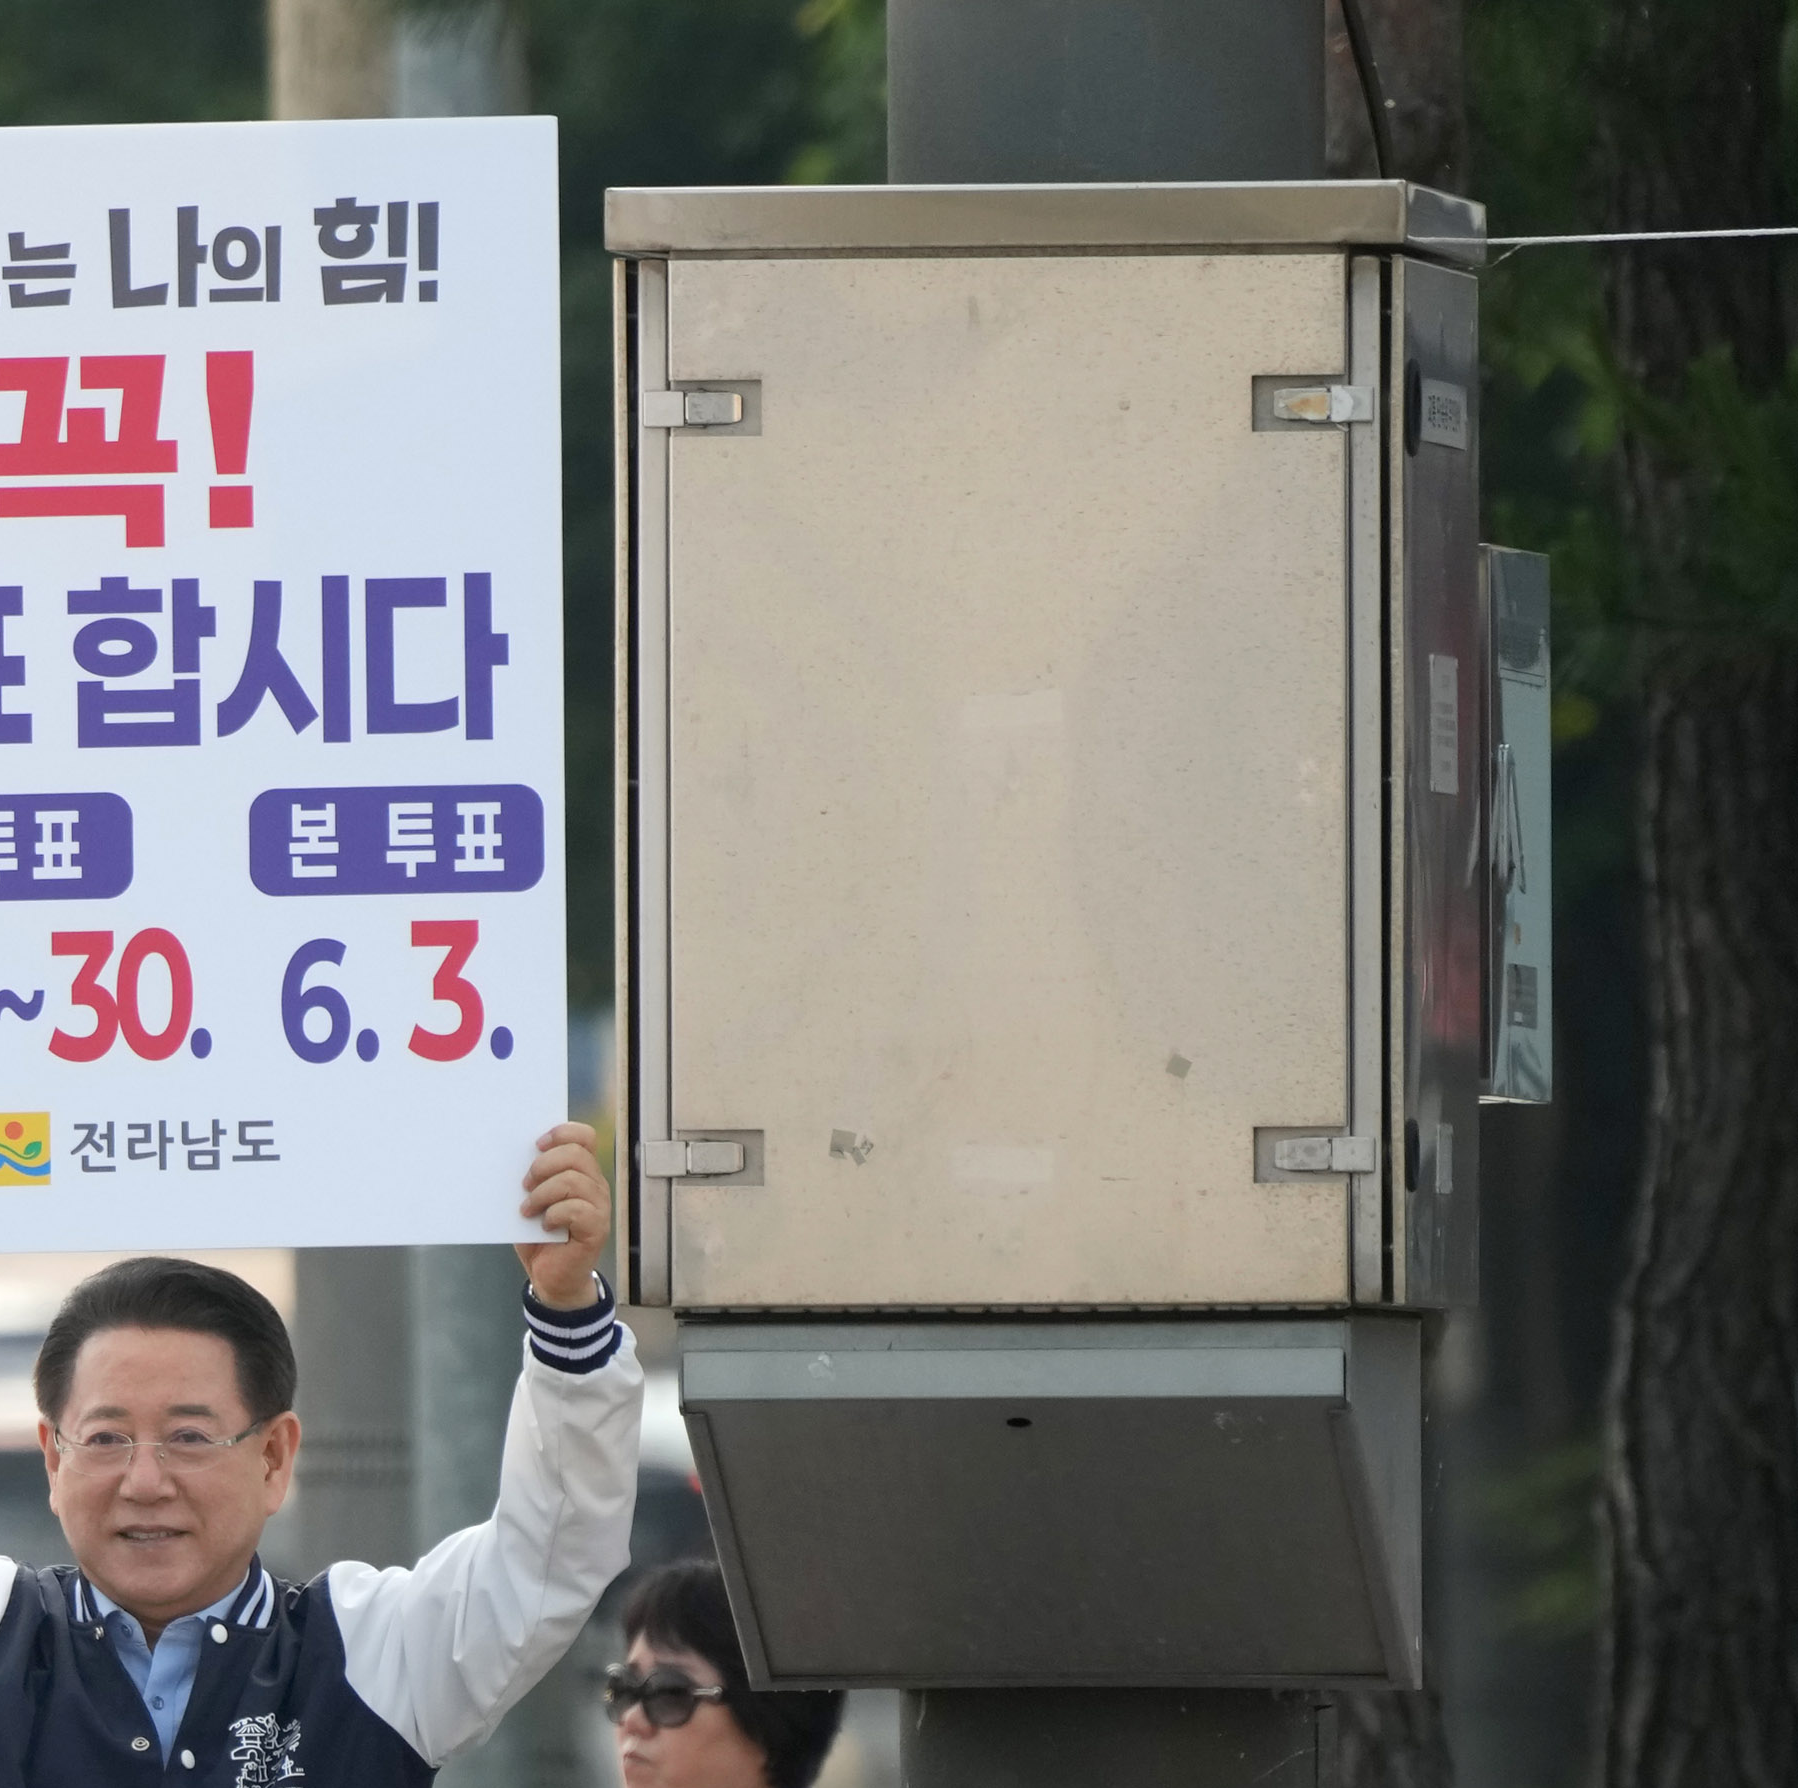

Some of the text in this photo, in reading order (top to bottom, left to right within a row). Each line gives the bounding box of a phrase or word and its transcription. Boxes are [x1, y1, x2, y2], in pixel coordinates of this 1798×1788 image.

[109, 206, 281, 308] 나의
[314, 197, 439, 305] 힘!
[68, 573, 508, 748] 합시다
[71, 1119, 280, 1172] 전라남도
